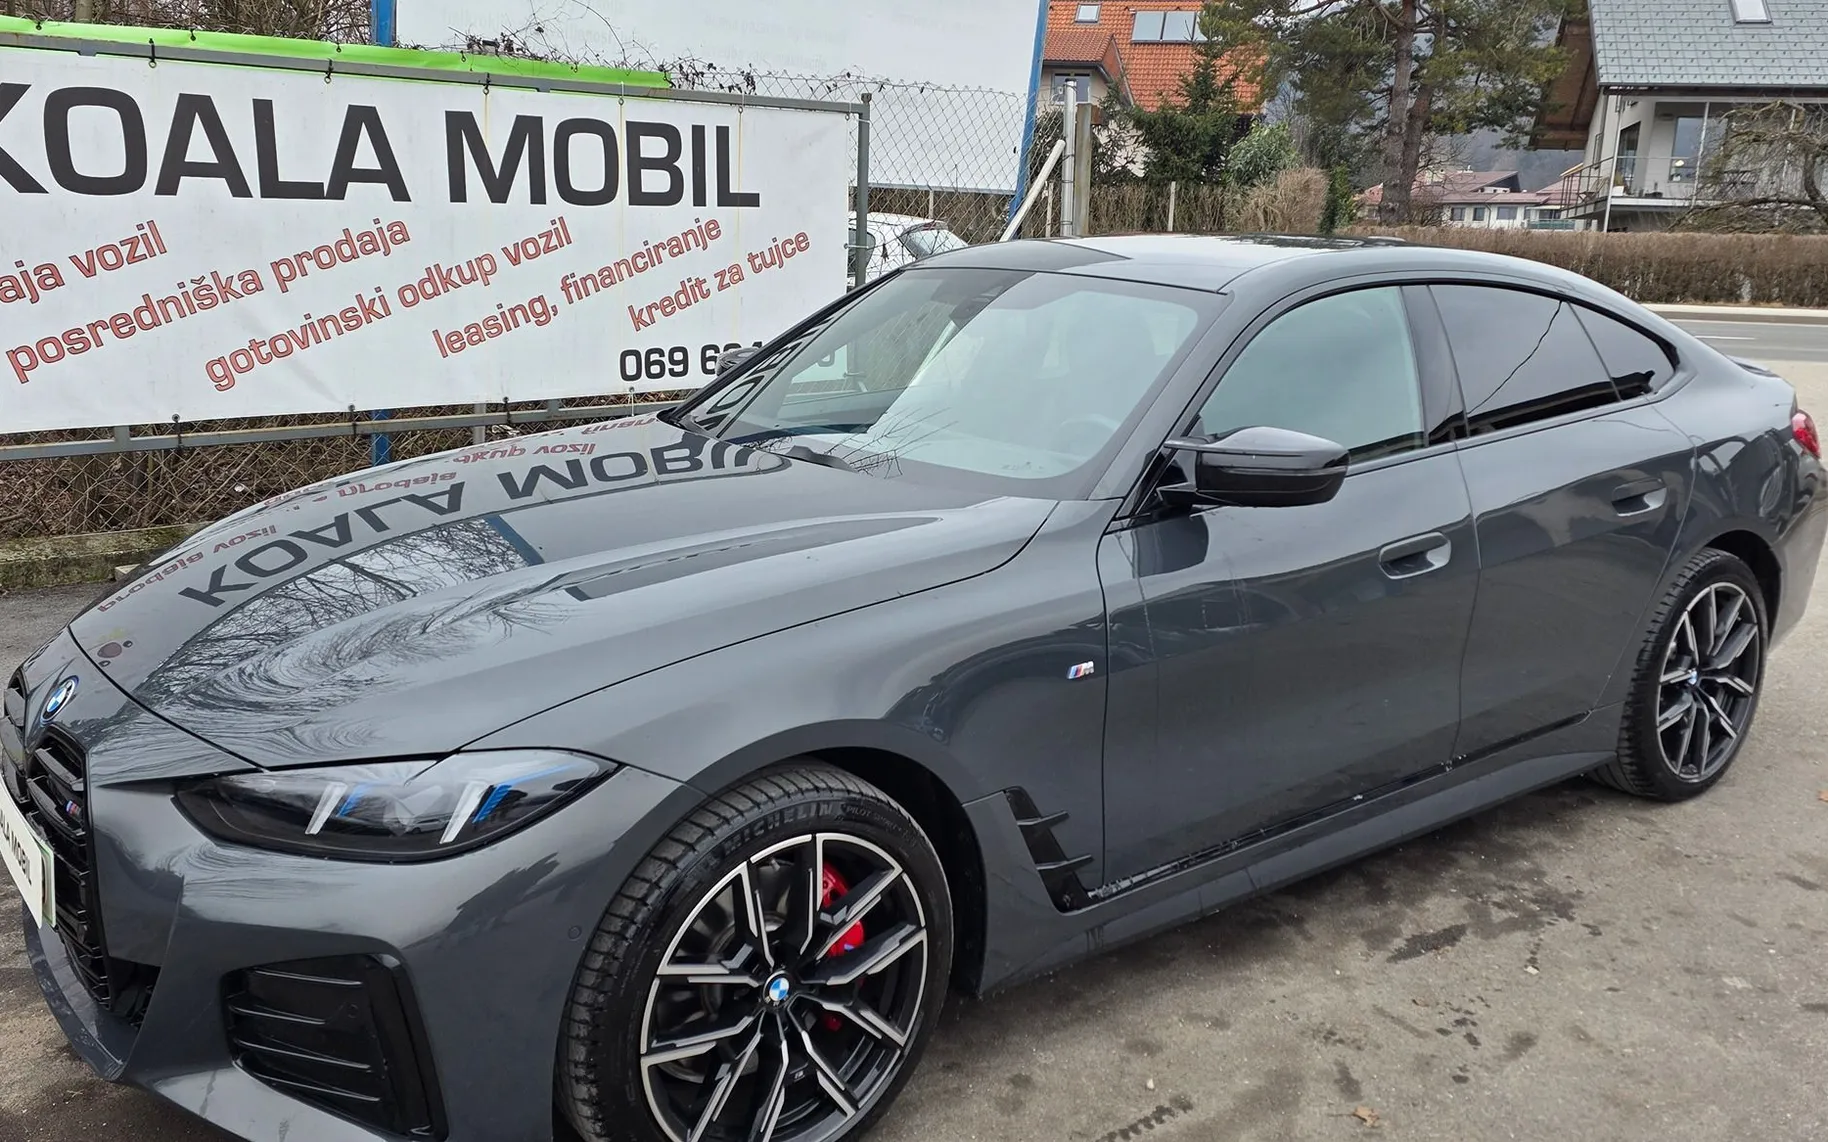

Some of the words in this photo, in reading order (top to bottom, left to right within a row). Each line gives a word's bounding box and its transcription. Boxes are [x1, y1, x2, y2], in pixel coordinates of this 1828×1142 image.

[444, 109, 761, 209] MOBIL
[6, 268, 264, 384] posredniška
[270, 217, 411, 293] prodaja
[69, 219, 168, 280] vozil
[432, 294, 558, 359] leasing,
[561, 217, 723, 305] financiranje
[628, 280, 711, 332] kredit
[714, 260, 745, 293] za
[747, 229, 811, 275] tujce
[205, 286, 392, 392] gotovinski
[396, 252, 497, 309] odkup
[502, 216, 572, 267] vozil
[619, 346, 690, 381] 069
